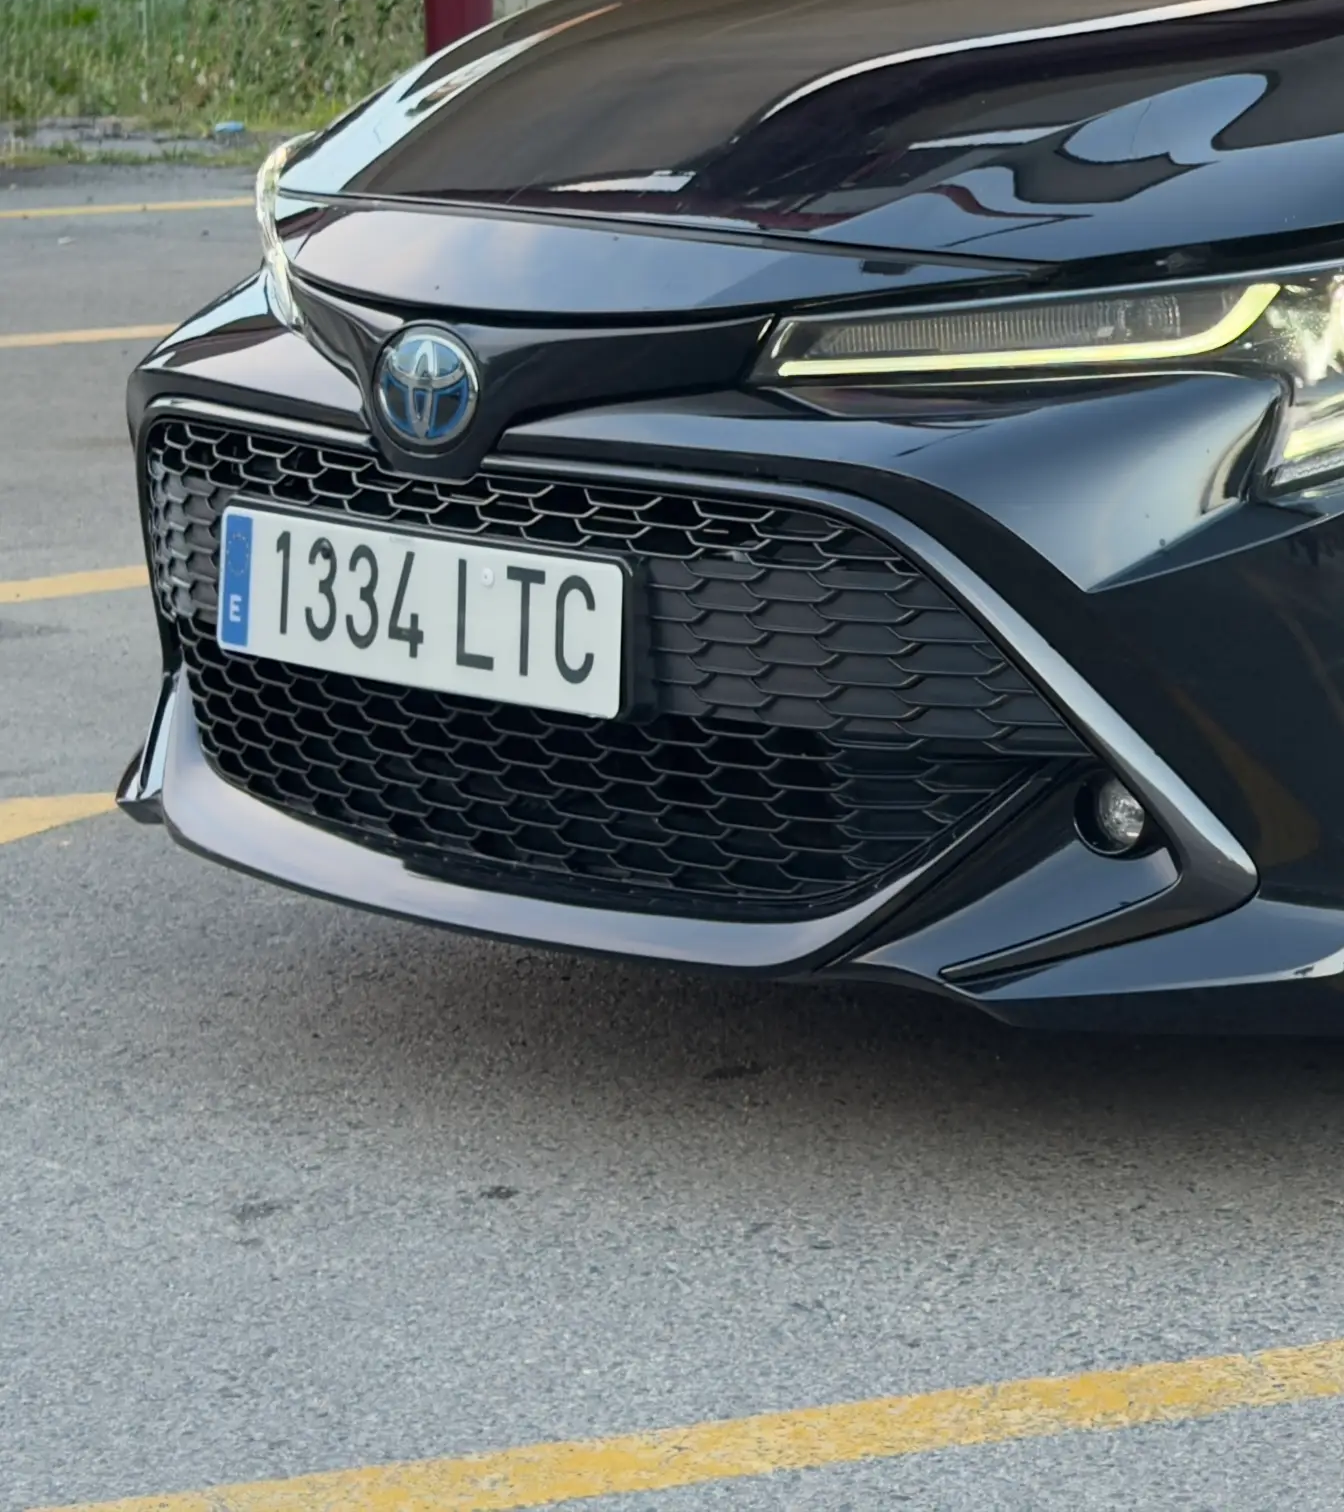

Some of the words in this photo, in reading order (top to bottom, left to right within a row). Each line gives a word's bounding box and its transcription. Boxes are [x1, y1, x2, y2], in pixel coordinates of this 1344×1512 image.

[229, 594, 243, 622] E
[276, 530, 424, 659] 1334
[456, 558, 596, 684] LTC
